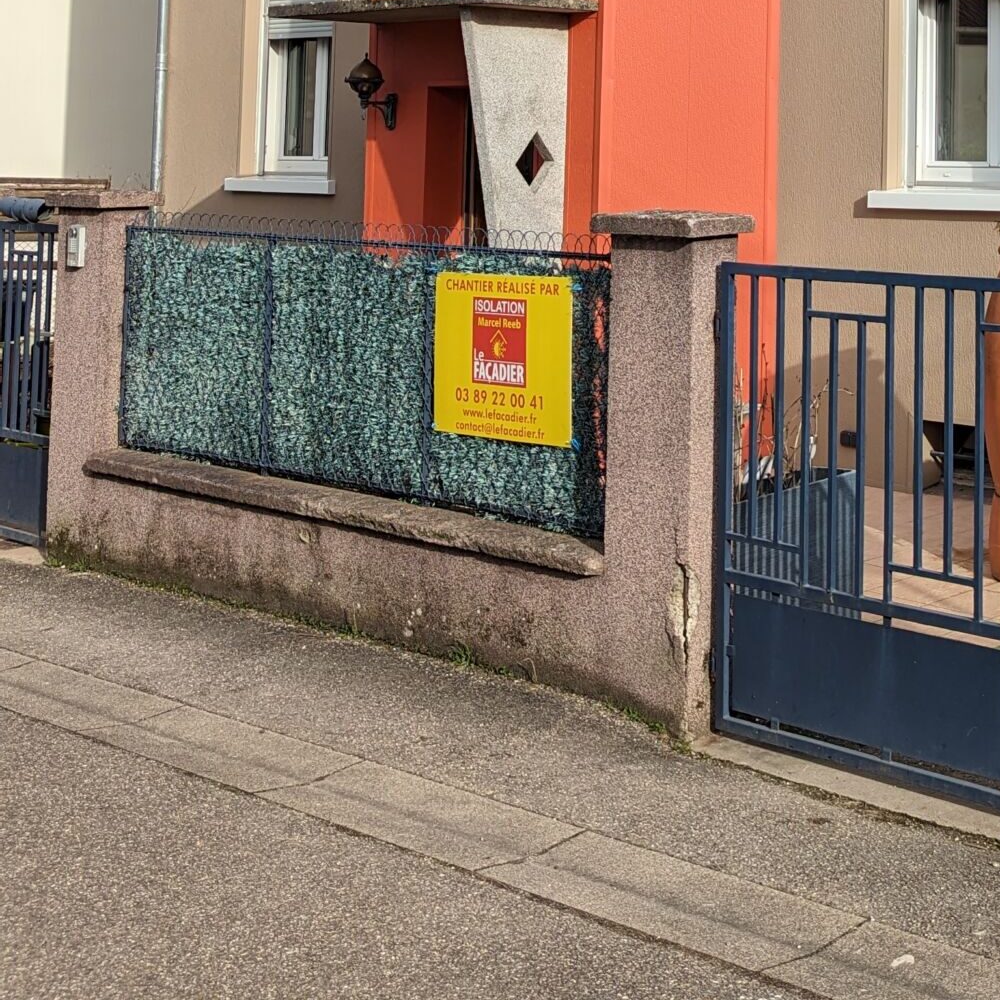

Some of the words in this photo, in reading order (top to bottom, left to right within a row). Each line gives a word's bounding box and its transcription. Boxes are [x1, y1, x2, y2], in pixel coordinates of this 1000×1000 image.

[446, 279, 493, 293] CHANTIER
[497, 278, 535, 295] RÉALISÉ
[540, 284, 560, 296] PAR
[475, 300, 525, 314] ISOLATION
[478, 317, 501, 328] Marcel
[503, 319, 521, 329] Reeb
[474, 348, 484, 360] Le
[474, 361, 524, 384] FAÇADIER
[456, 388, 469, 402] 03
[474, 390, 487, 404] 89
[492, 392, 505, 407] 22
[511, 394, 525, 408] 00
[530, 396, 543, 410] 41
[463, 408, 537, 424] www.lefacadier.fr
[456, 420, 545, 440] contact@lefacadier.fr
